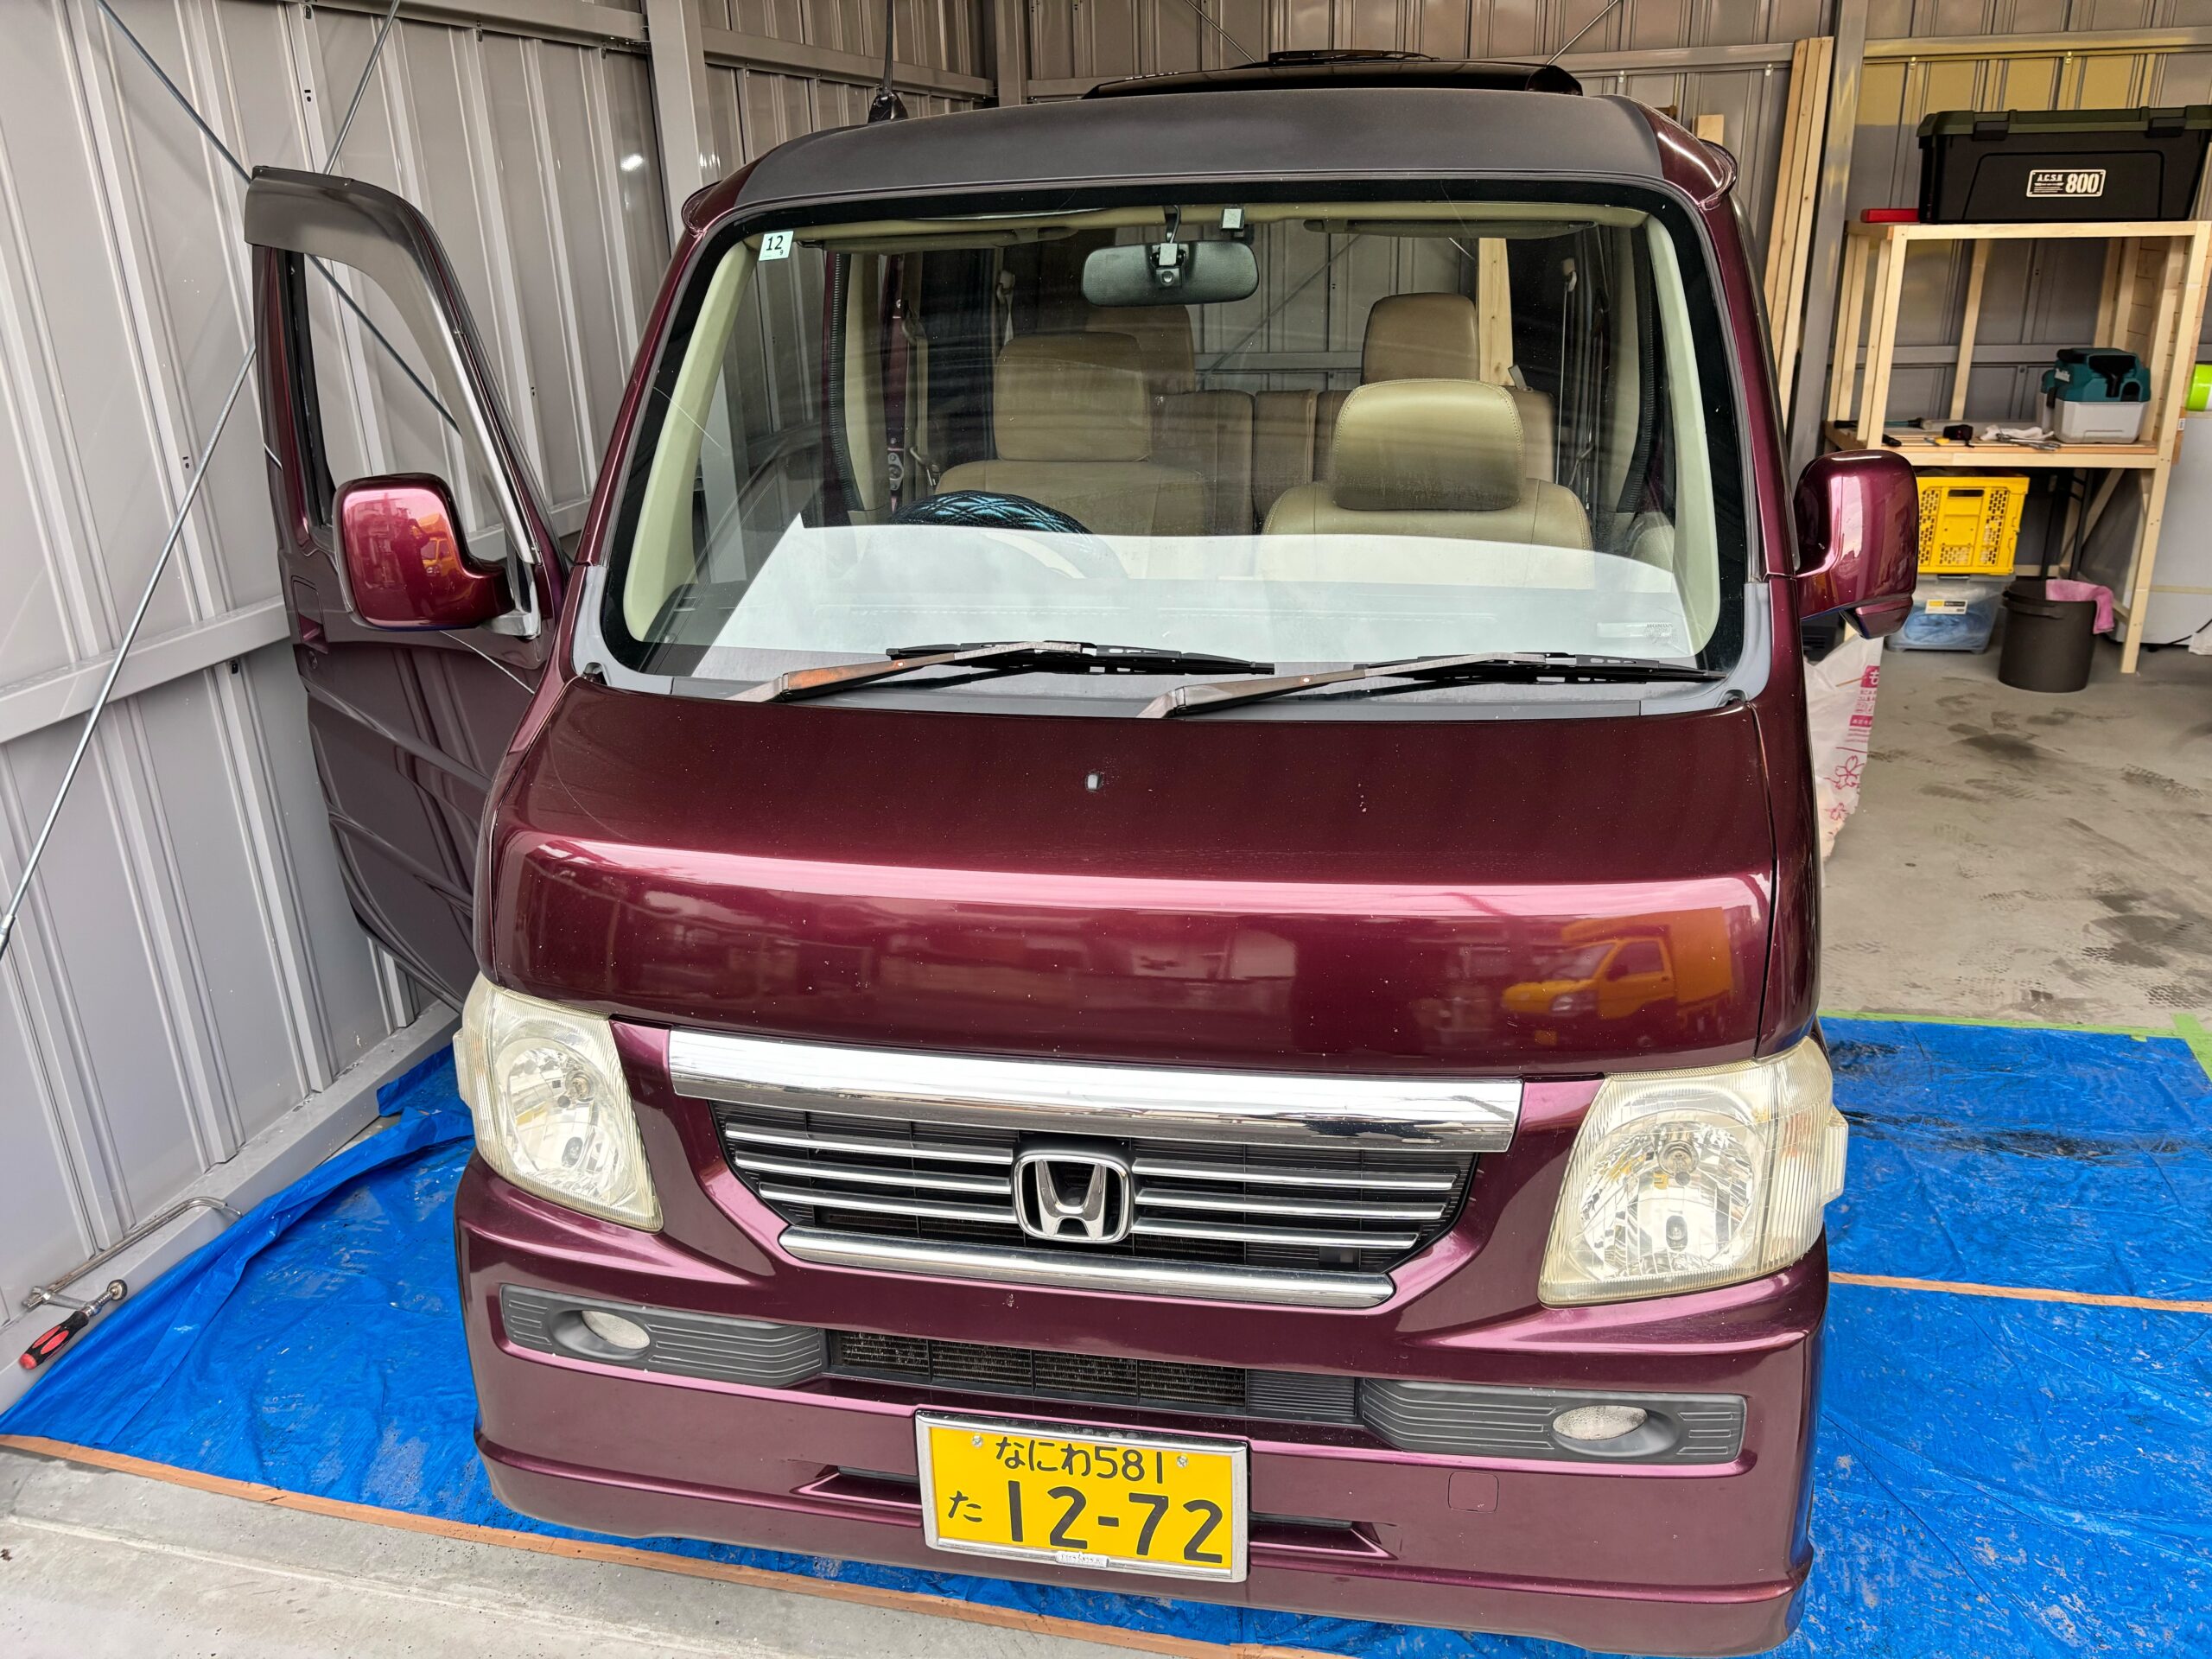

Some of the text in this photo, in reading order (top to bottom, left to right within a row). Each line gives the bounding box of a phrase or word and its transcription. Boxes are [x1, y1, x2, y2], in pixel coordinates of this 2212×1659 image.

[2065, 173, 2100, 194] 800
[766, 234, 784, 251] 12
[948, 1480, 1223, 1564] た 12-72
